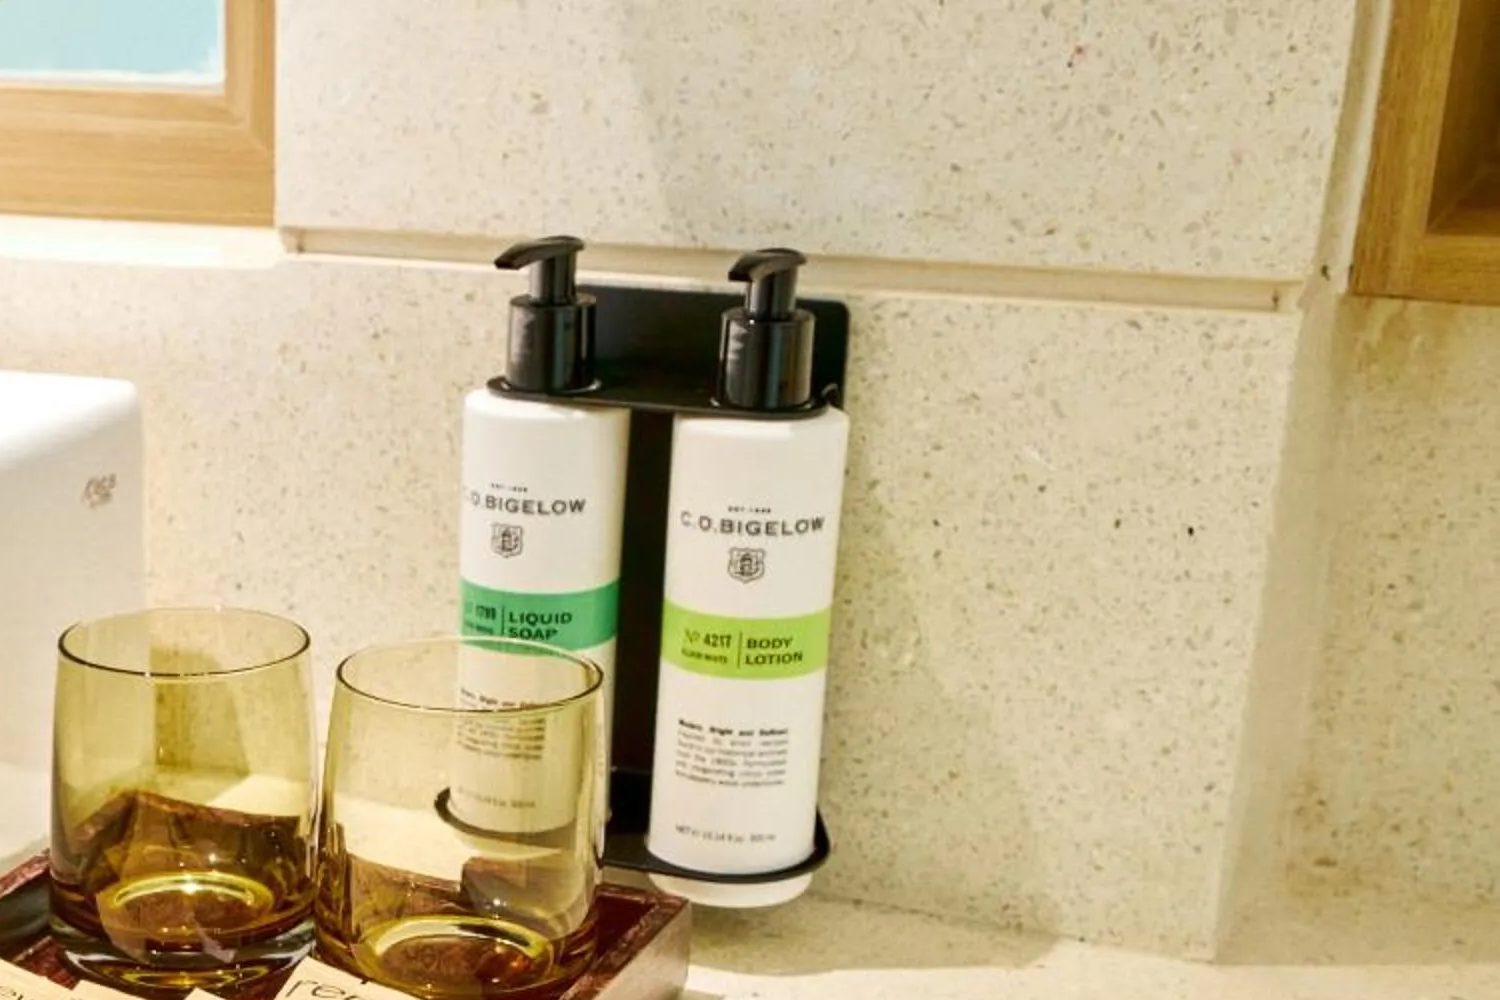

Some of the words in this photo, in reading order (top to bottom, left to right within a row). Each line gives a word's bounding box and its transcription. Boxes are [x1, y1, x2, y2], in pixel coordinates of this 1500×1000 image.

[508, 611, 572, 627] LIQUID
[508, 627, 560, 641] SOAP
[747, 637, 794, 650] BODY
[745, 650, 804, 666] LOTION
